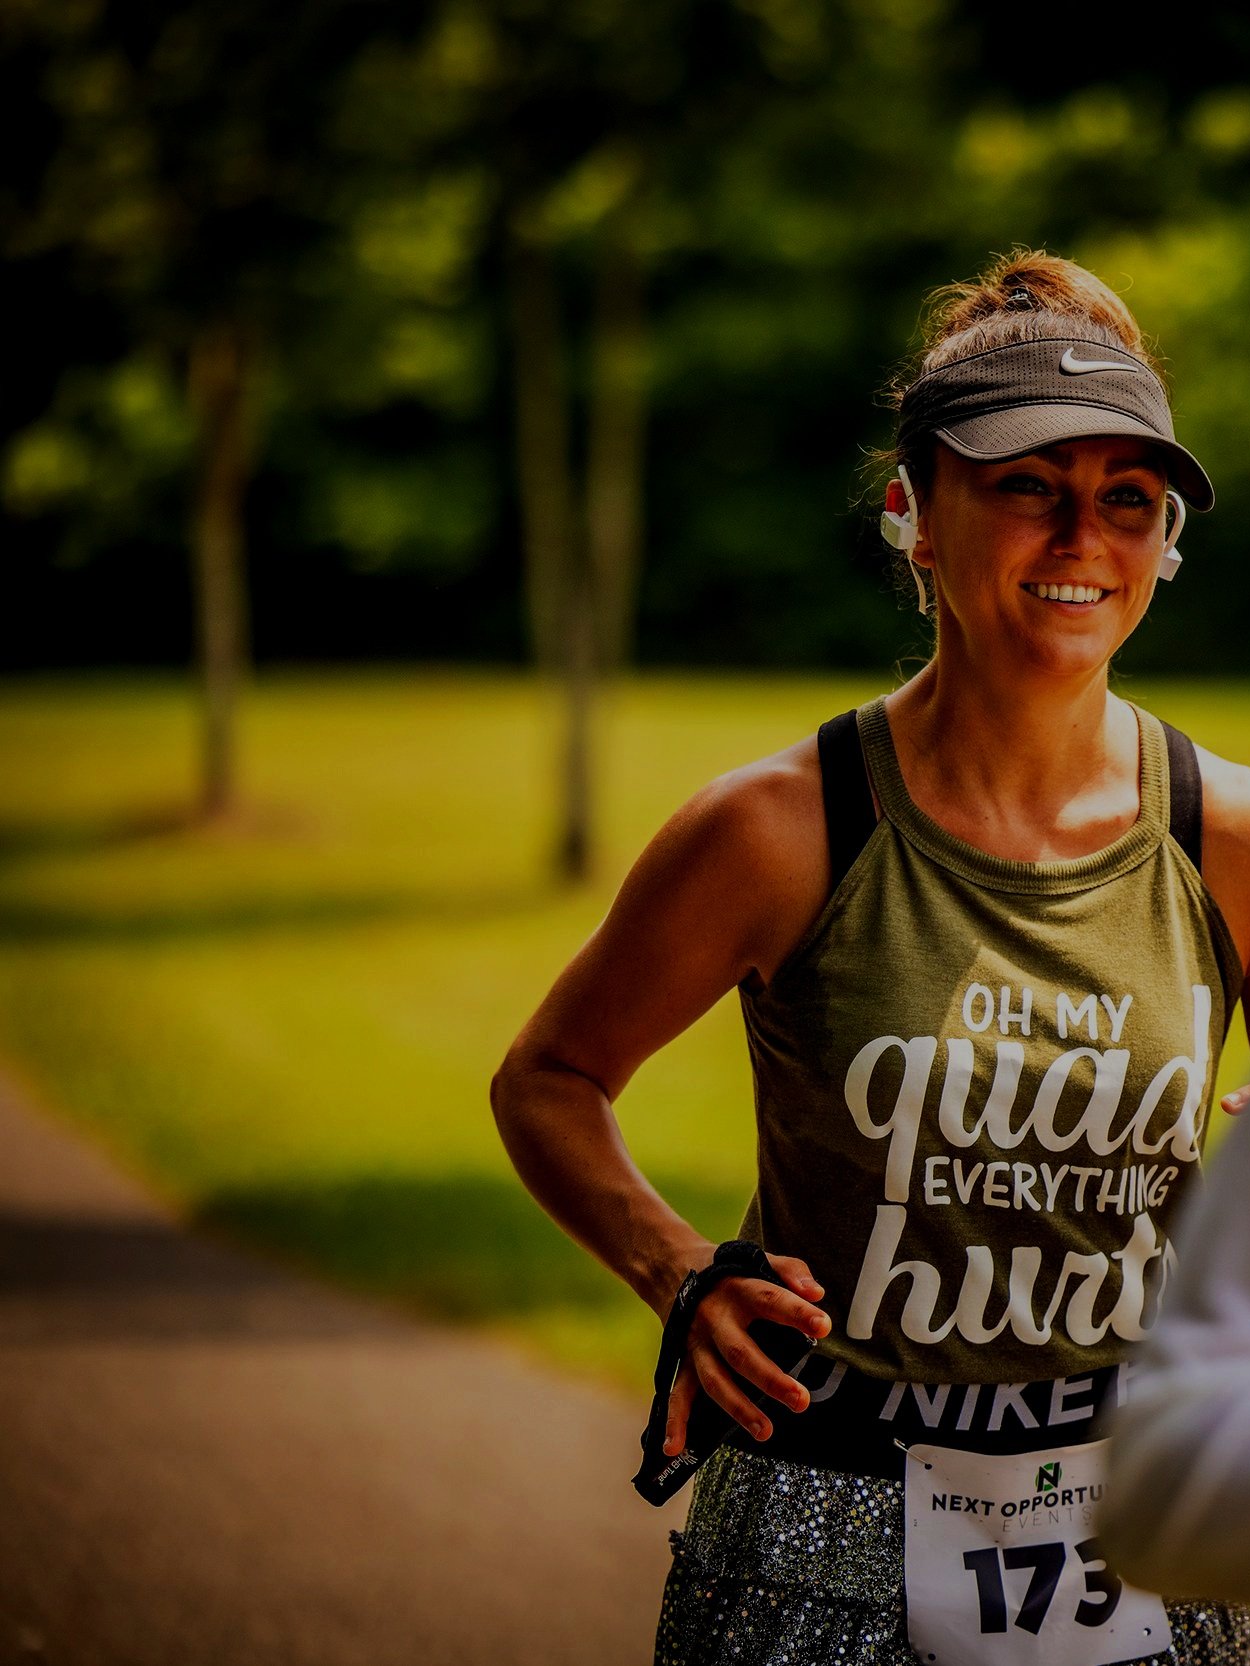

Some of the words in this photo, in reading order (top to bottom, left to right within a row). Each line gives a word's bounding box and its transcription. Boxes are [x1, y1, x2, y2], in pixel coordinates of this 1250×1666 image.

[961, 981, 1034, 1036] OH
[1056, 991, 1134, 1043] MY
[923, 1155, 1179, 1217] EVERYTHING
[845, 1204, 1178, 1346] hurt
[879, 1376, 1095, 1431] NIKE
[932, 1493, 995, 1516] NEXT
[1000, 1483, 1108, 1517] OPPORTU
[1002, 1507, 1093, 1532] EVENTS
[962, 1536, 1122, 1635] 173
